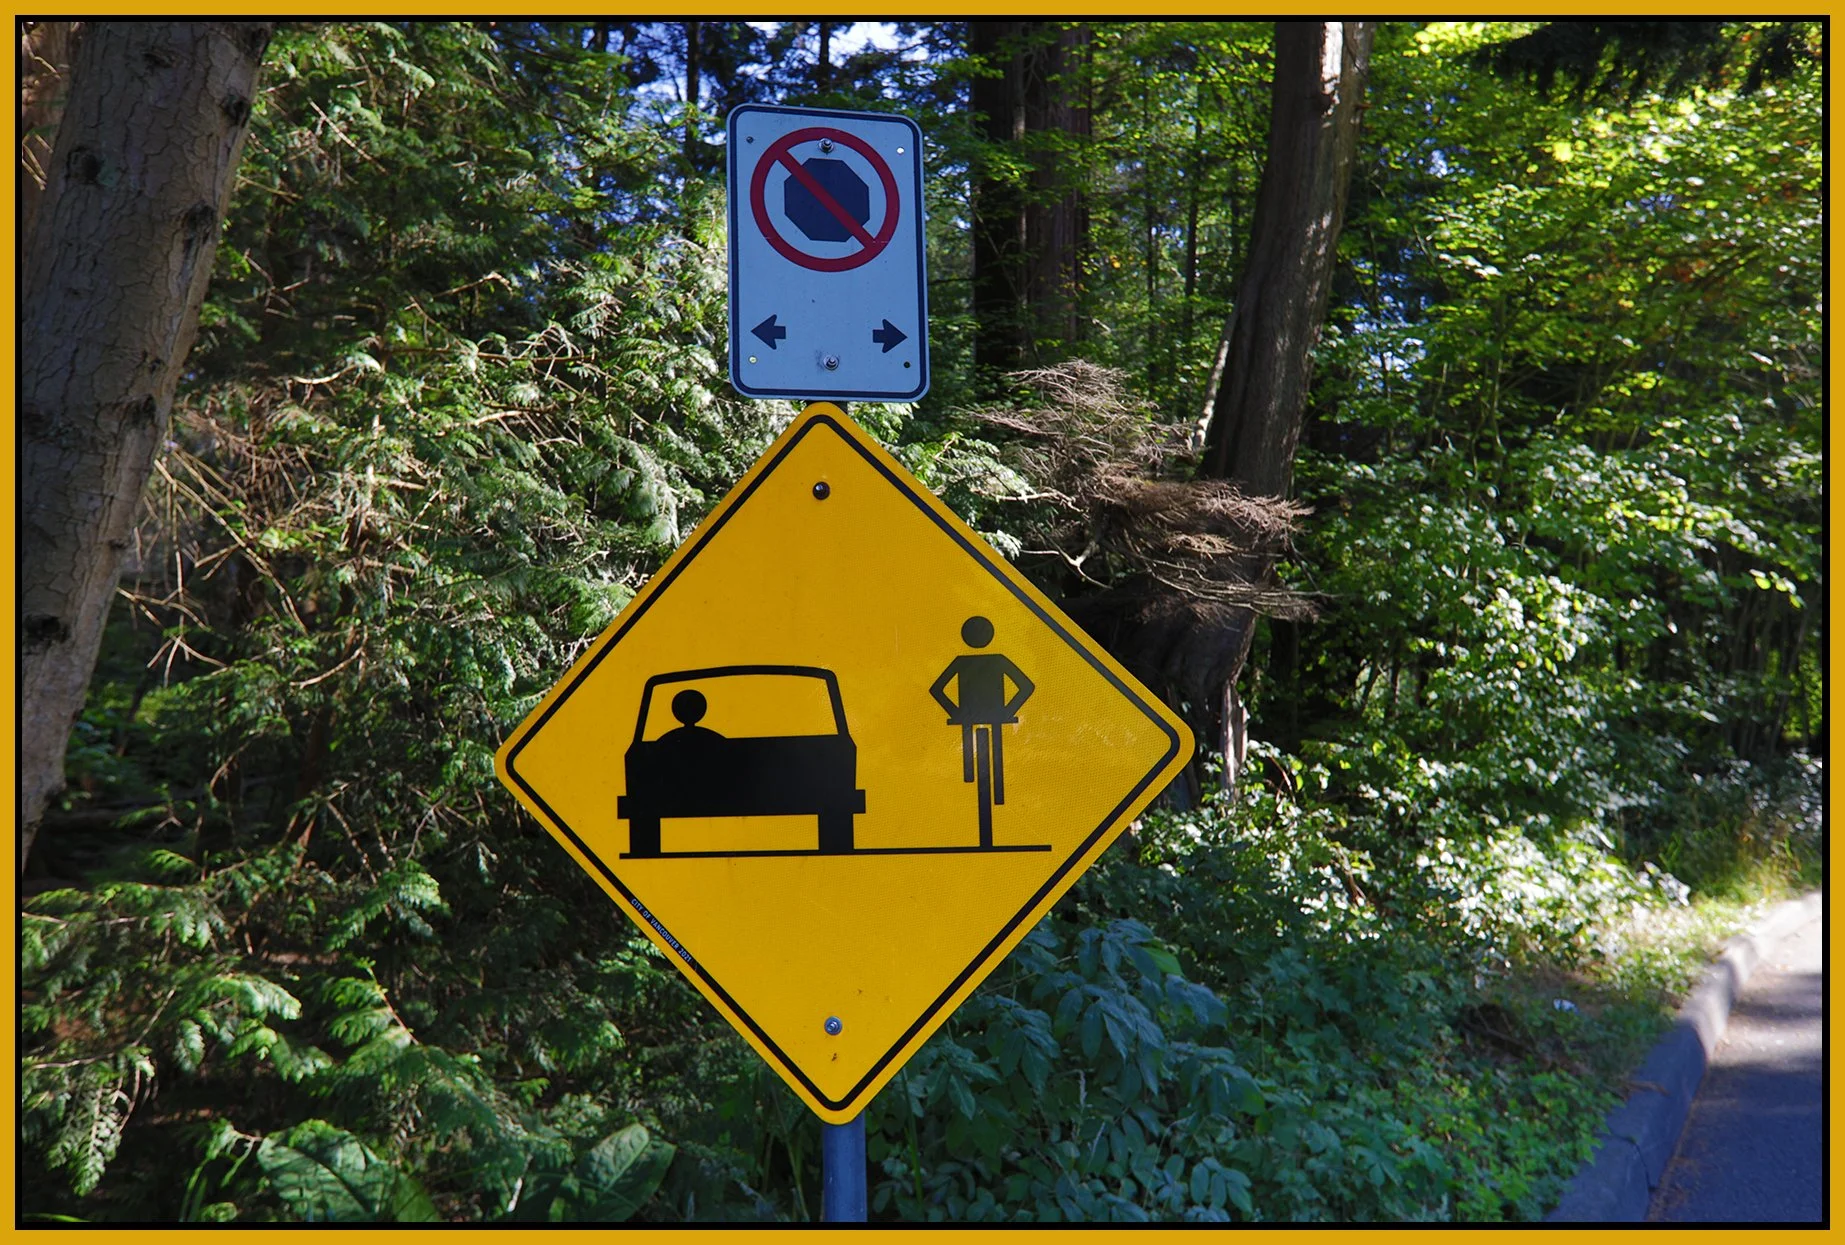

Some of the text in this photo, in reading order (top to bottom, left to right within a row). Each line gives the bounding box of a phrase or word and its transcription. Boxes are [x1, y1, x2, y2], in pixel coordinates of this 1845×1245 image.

[631, 898, 692, 962] CITY OF VANCOUVER 2021
